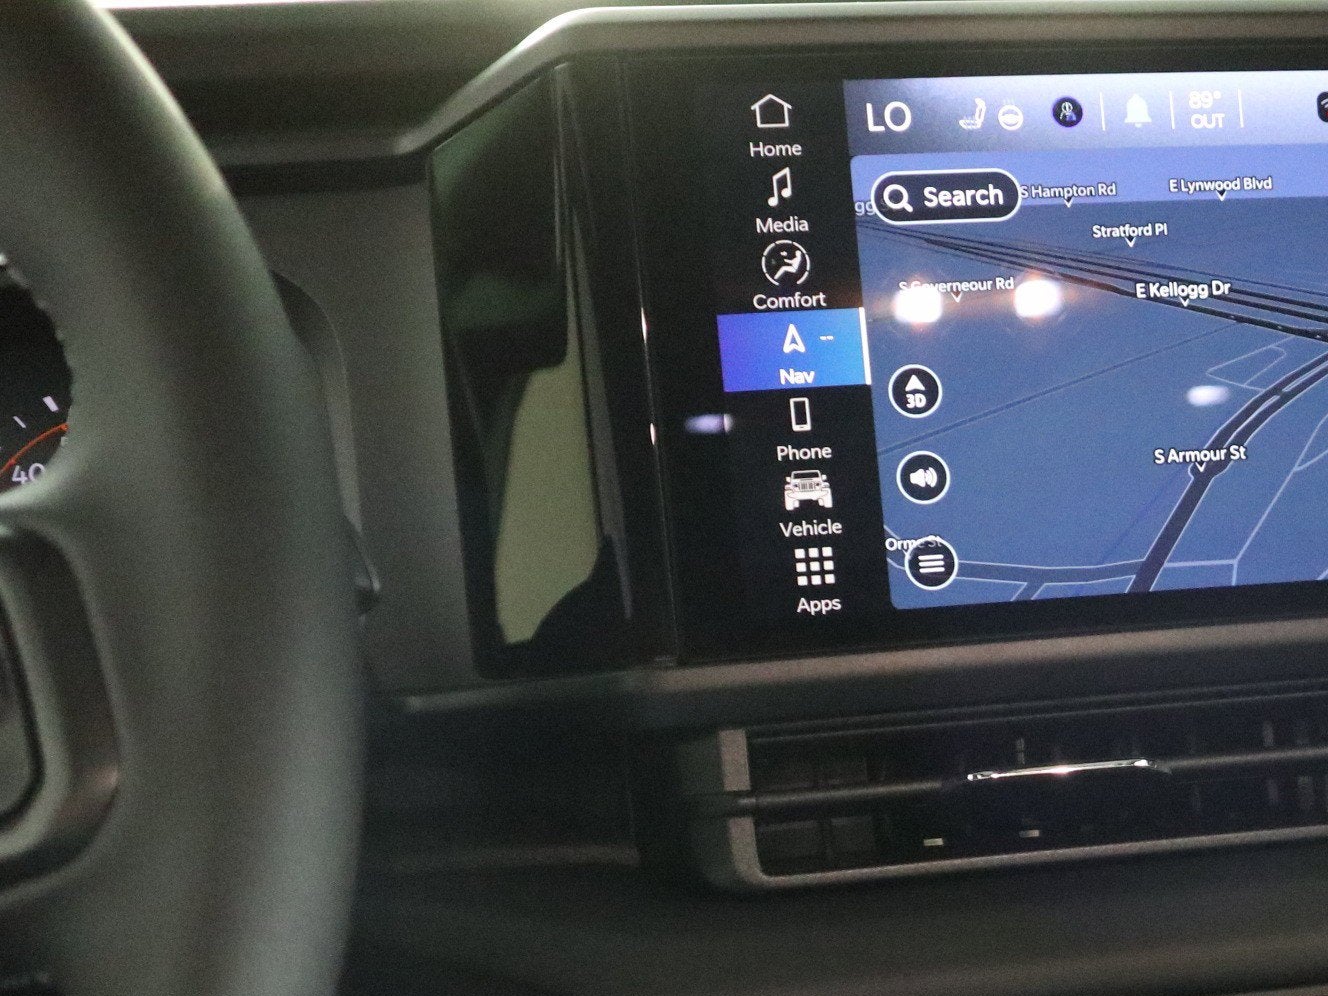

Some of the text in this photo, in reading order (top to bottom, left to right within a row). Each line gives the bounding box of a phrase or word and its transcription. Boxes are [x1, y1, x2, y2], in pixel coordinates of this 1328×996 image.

[866, 101, 912, 133] LO
[1190, 111, 1226, 129] OUT
[749, 141, 802, 158] Home
[1020, 183, 1117, 201] S Hampton Rd
[1169, 176, 1274, 195] E Lynwood Blvd
[923, 184, 1004, 209] Search
[755, 216, 809, 233] Media
[1092, 222, 1168, 239] Stratford Pl
[899, 281, 908, 292] S
[996, 277, 1014, 290] Rd
[1136, 280, 1231, 301] E Kellogg Dr
[752, 292, 826, 309] Comfort
[779, 369, 815, 385] Nav
[905, 393, 927, 408] 3D
[777, 444, 832, 461] Phone
[1154, 445, 1247, 463] S Armour St
[11, 462, 46, 486] 40
[779, 519, 843, 537] Vehicle
[797, 596, 842, 616] Apps
